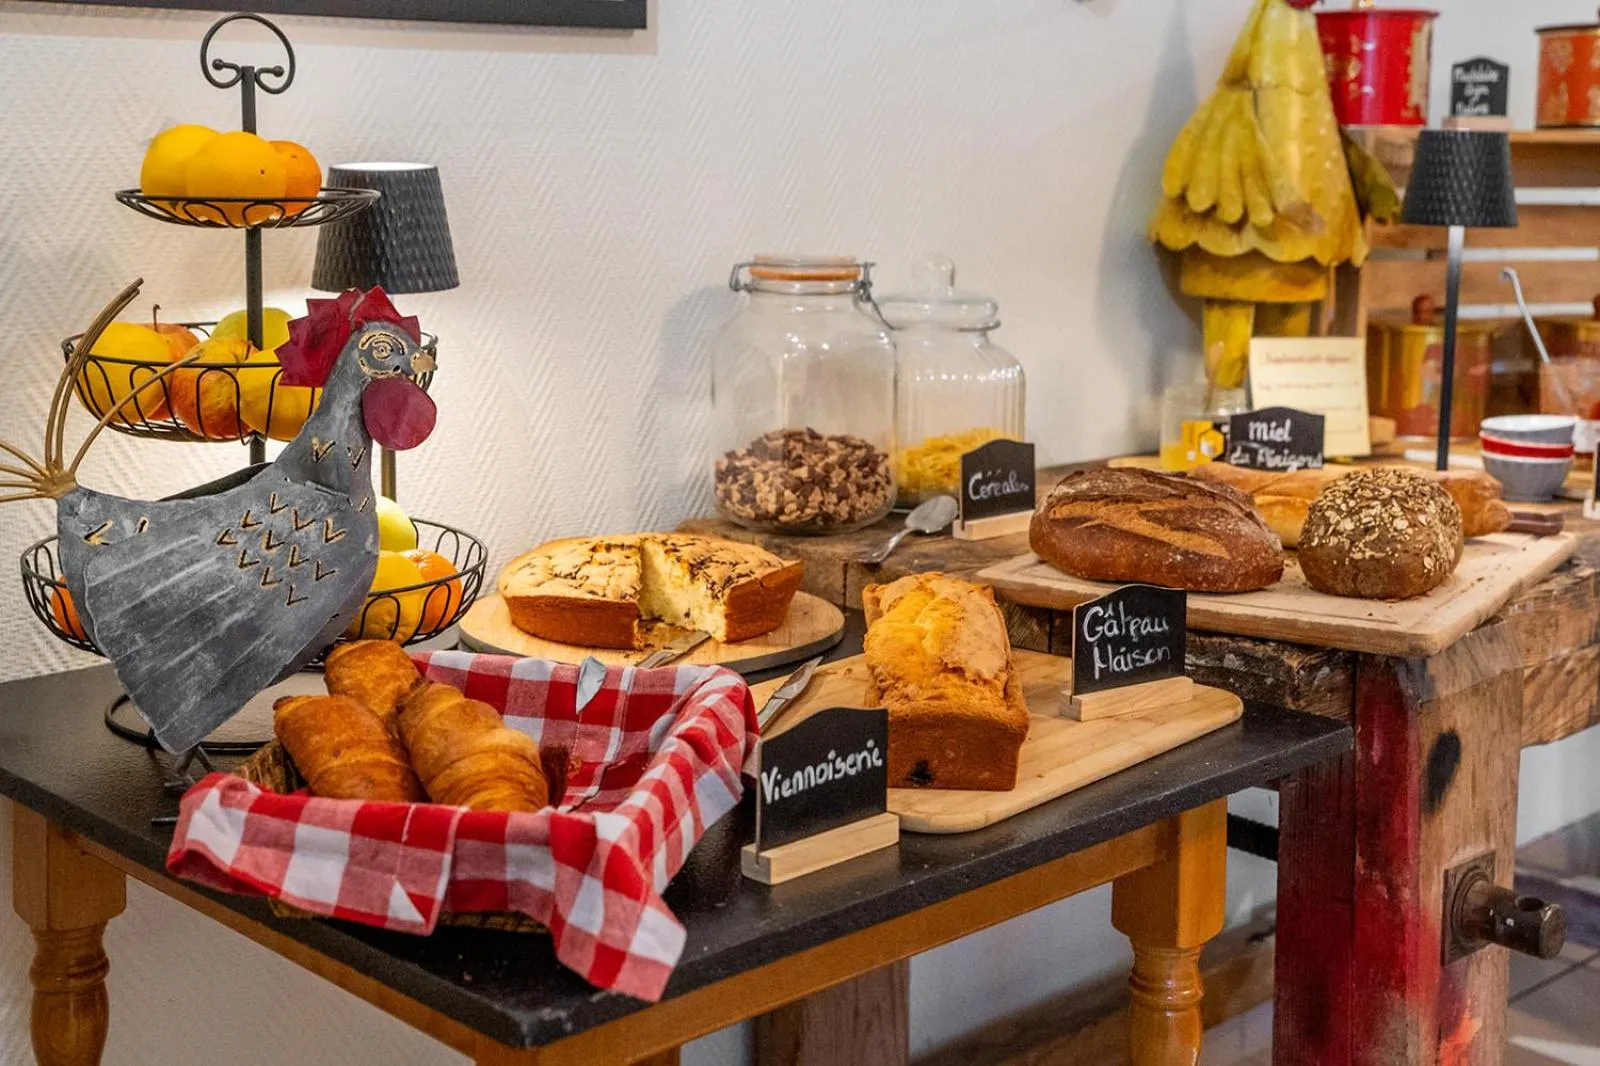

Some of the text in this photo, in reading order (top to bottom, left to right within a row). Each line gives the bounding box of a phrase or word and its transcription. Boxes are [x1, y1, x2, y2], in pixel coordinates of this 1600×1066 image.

[1247, 418, 1292, 442] Miel
[1083, 600, 1169, 642] Gâteau
[1093, 643, 1171, 680] Maison
